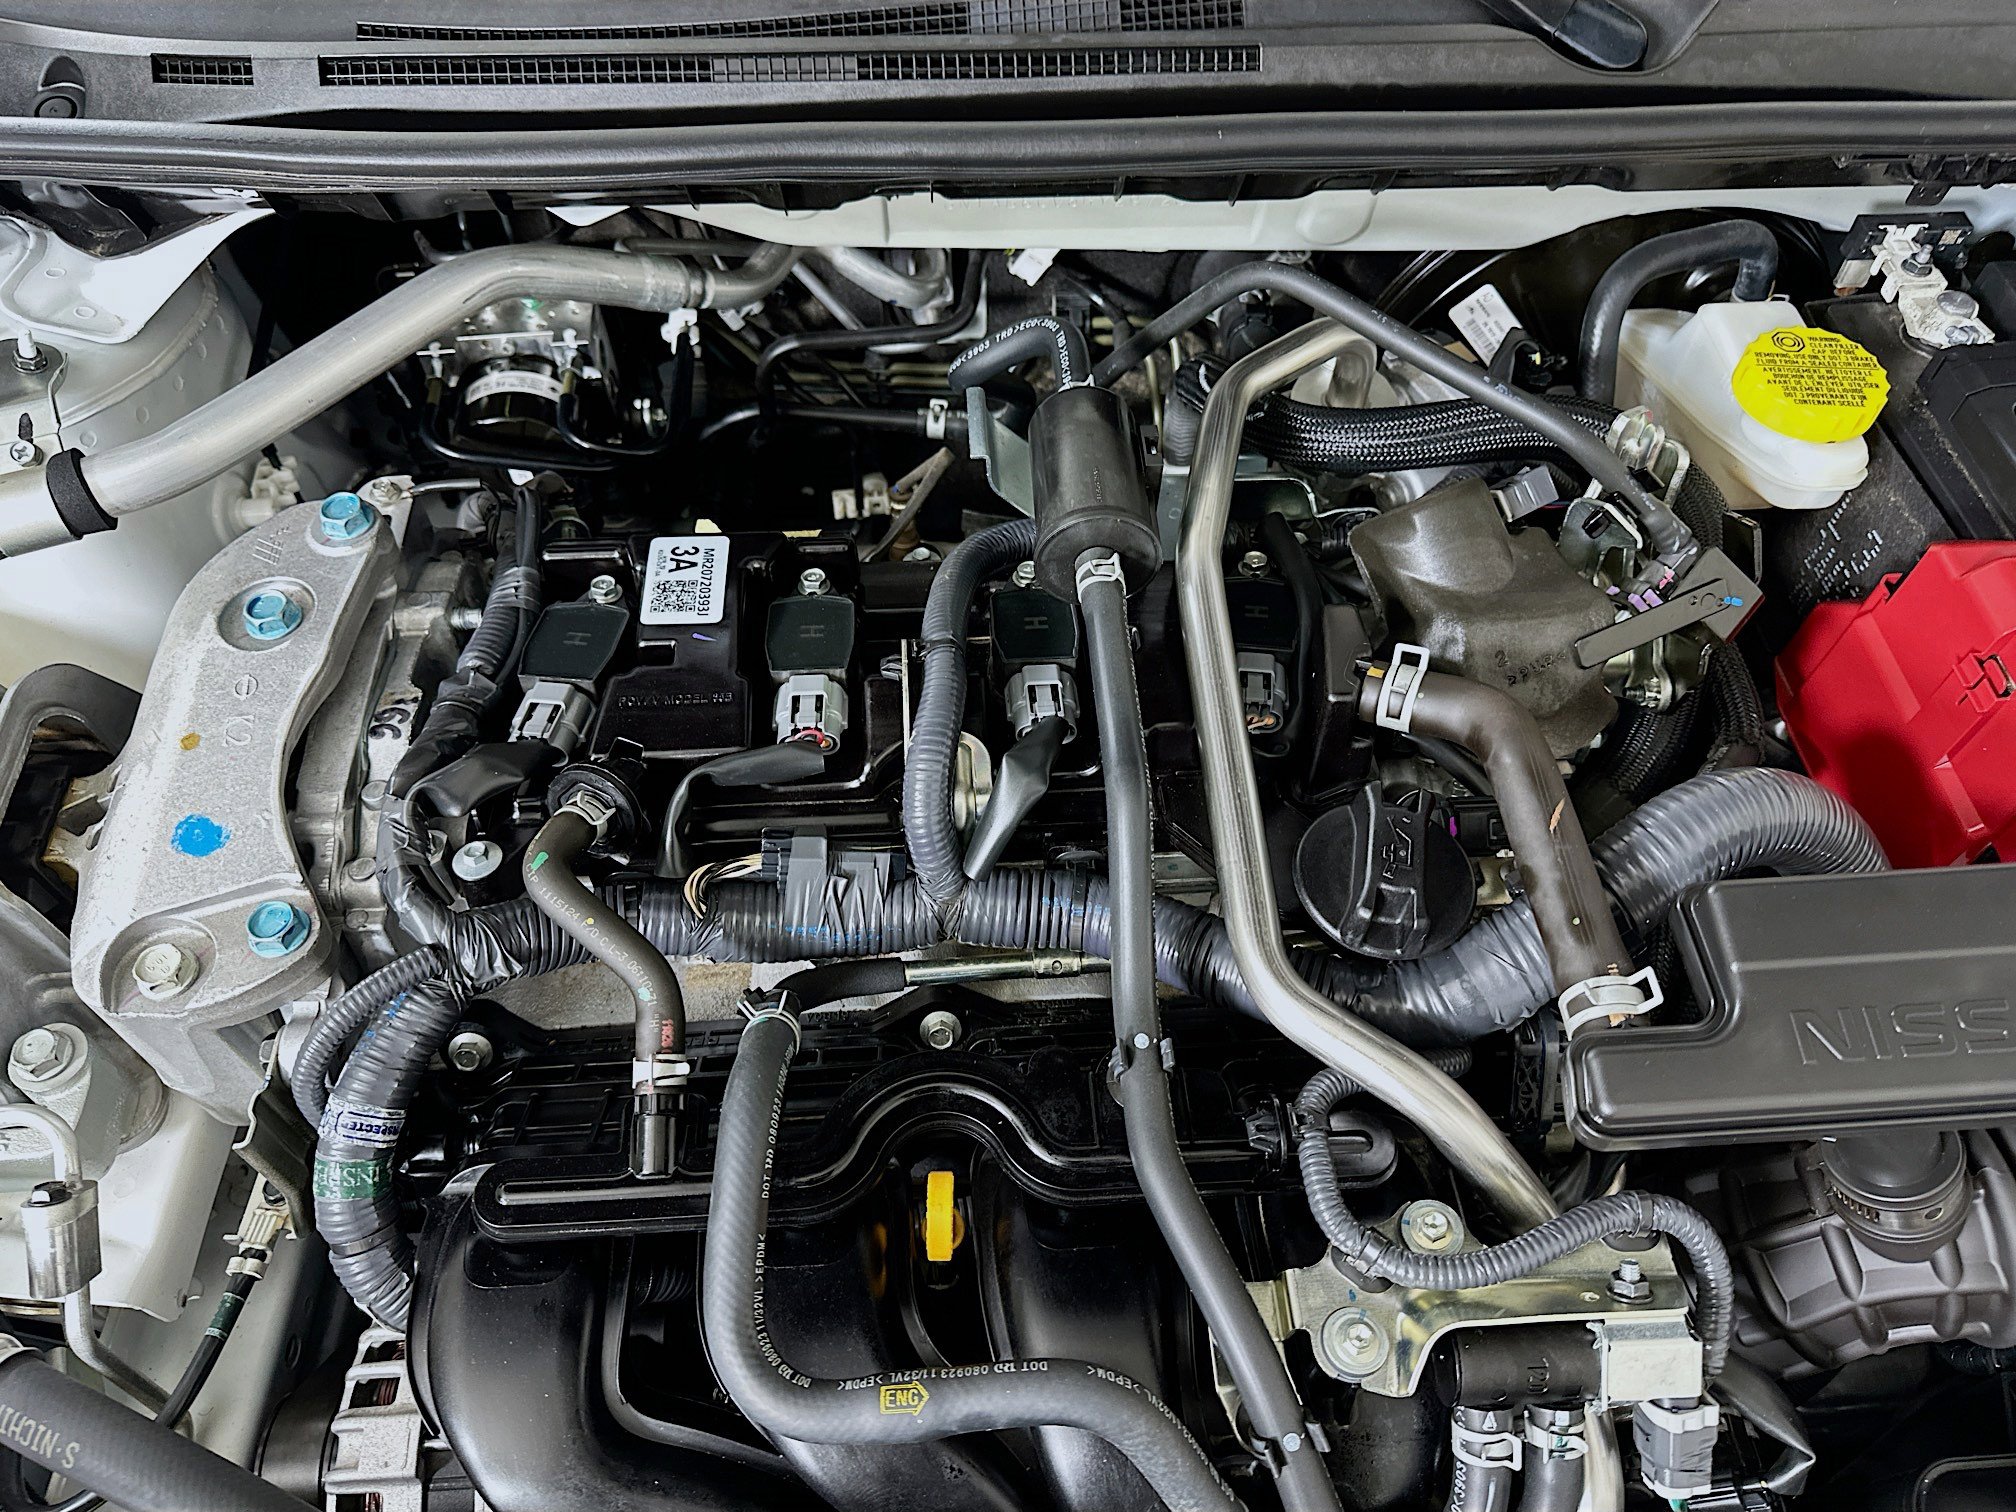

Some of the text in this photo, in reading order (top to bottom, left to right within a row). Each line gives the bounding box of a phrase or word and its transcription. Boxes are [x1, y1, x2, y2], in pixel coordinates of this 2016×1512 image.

[1809, 360, 1837, 368] SEALED
[668, 546, 700, 573] 3A
[1790, 998, 2016, 1064] NISS
[761, 1174, 771, 1200] DOT
[767, 1097, 783, 1145] 080923
[757, 1331, 782, 1367] 080923
[940, 1364, 989, 1379] 080923
[1021, 1360, 1049, 1372] DOT
[791, 1373, 813, 1389] DOT
[885, 1389, 919, 1408] ENG
